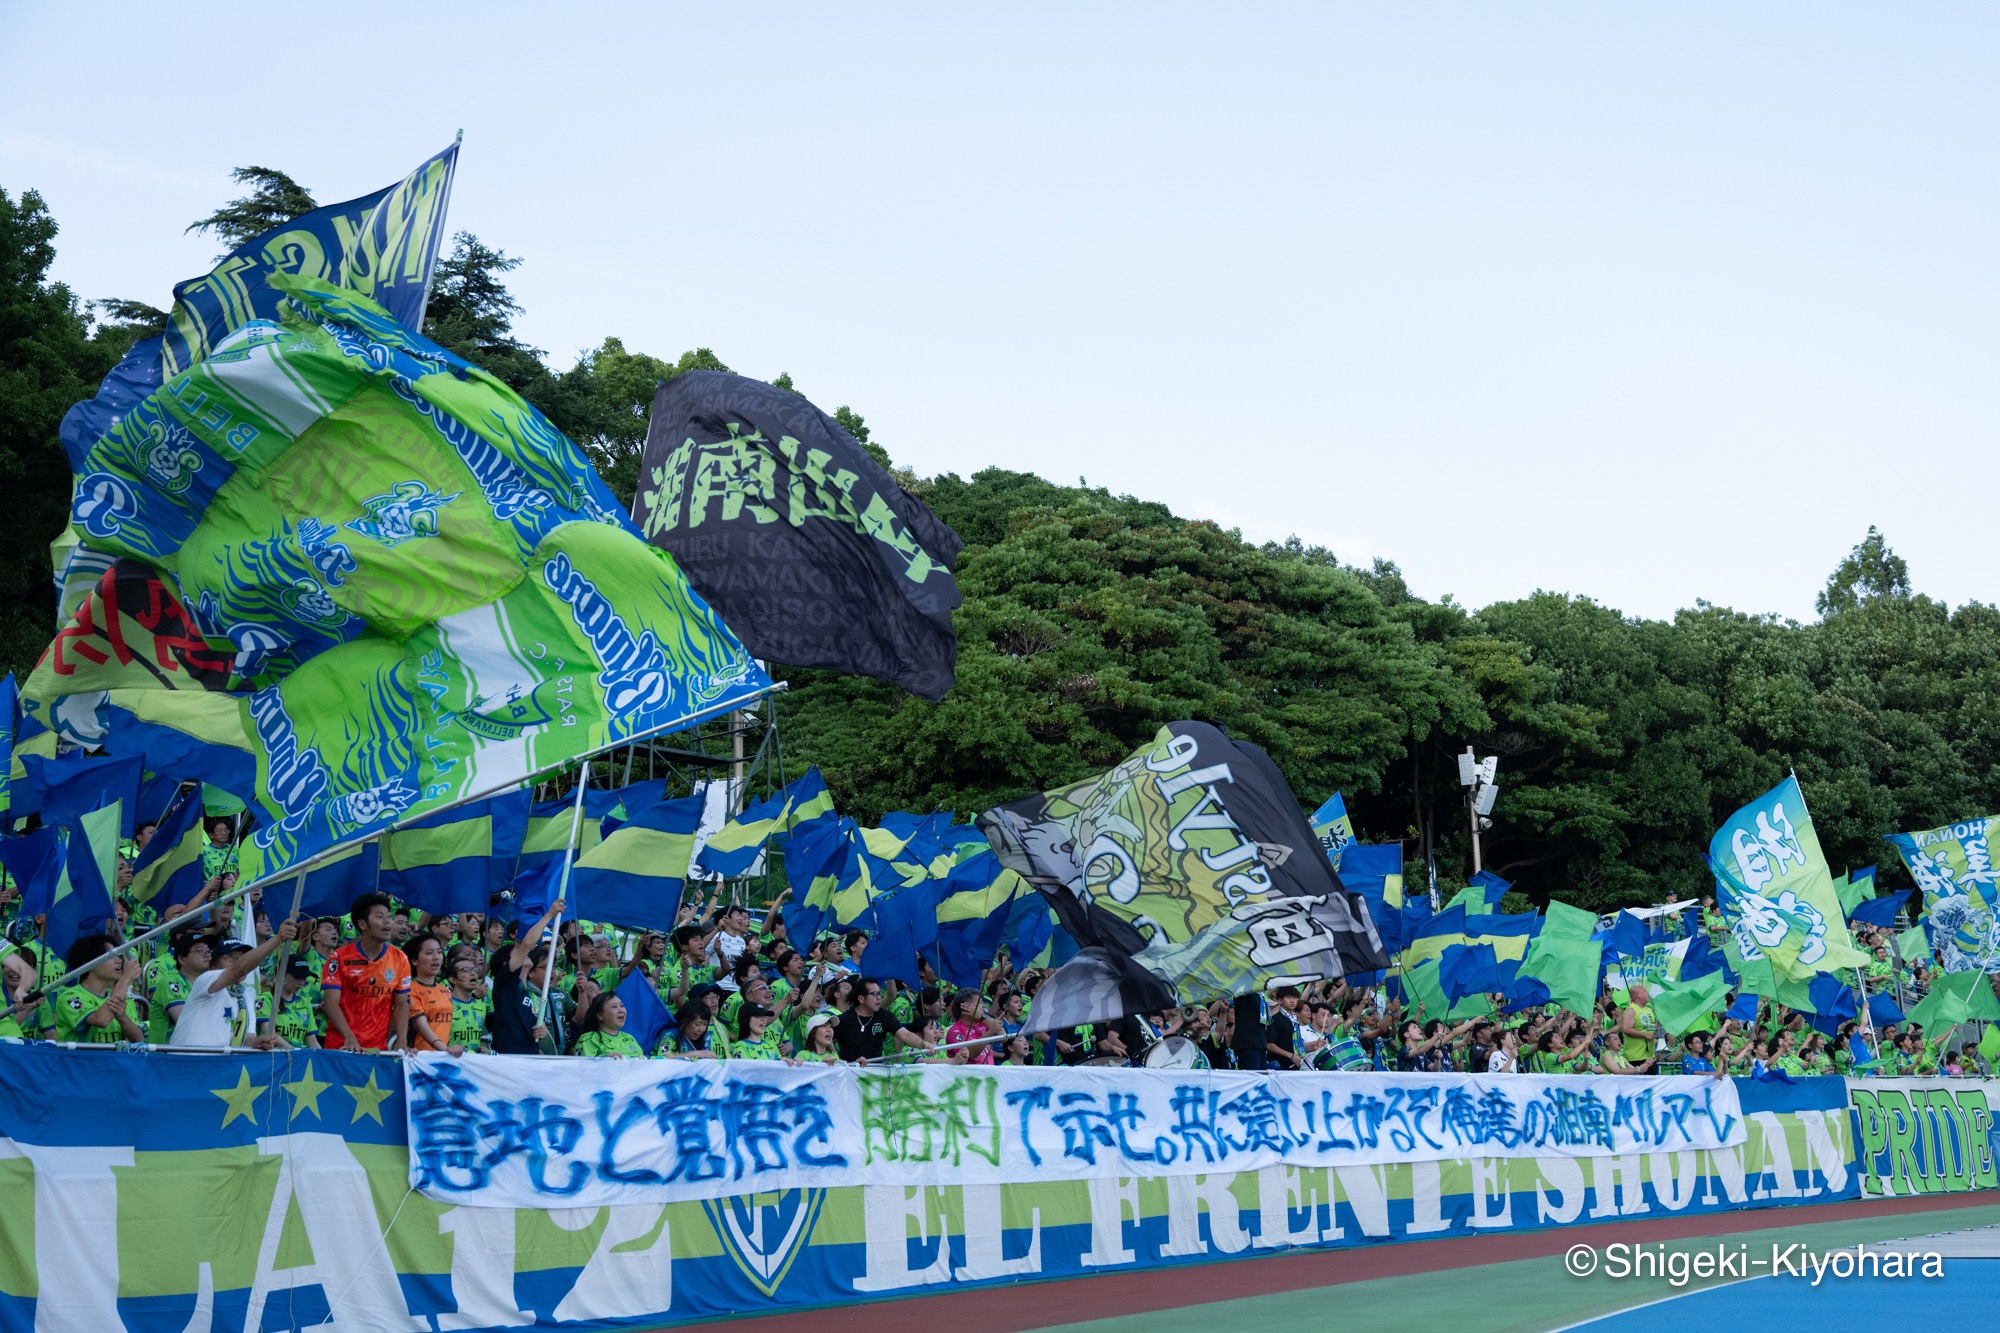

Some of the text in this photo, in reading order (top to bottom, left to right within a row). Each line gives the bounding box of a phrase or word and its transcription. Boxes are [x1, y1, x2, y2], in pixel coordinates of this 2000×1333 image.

[852, 1184, 1043, 1292] EL
[1536, 1107, 1849, 1225] SHONAN
[1853, 1087, 1994, 1195] PRIDE
